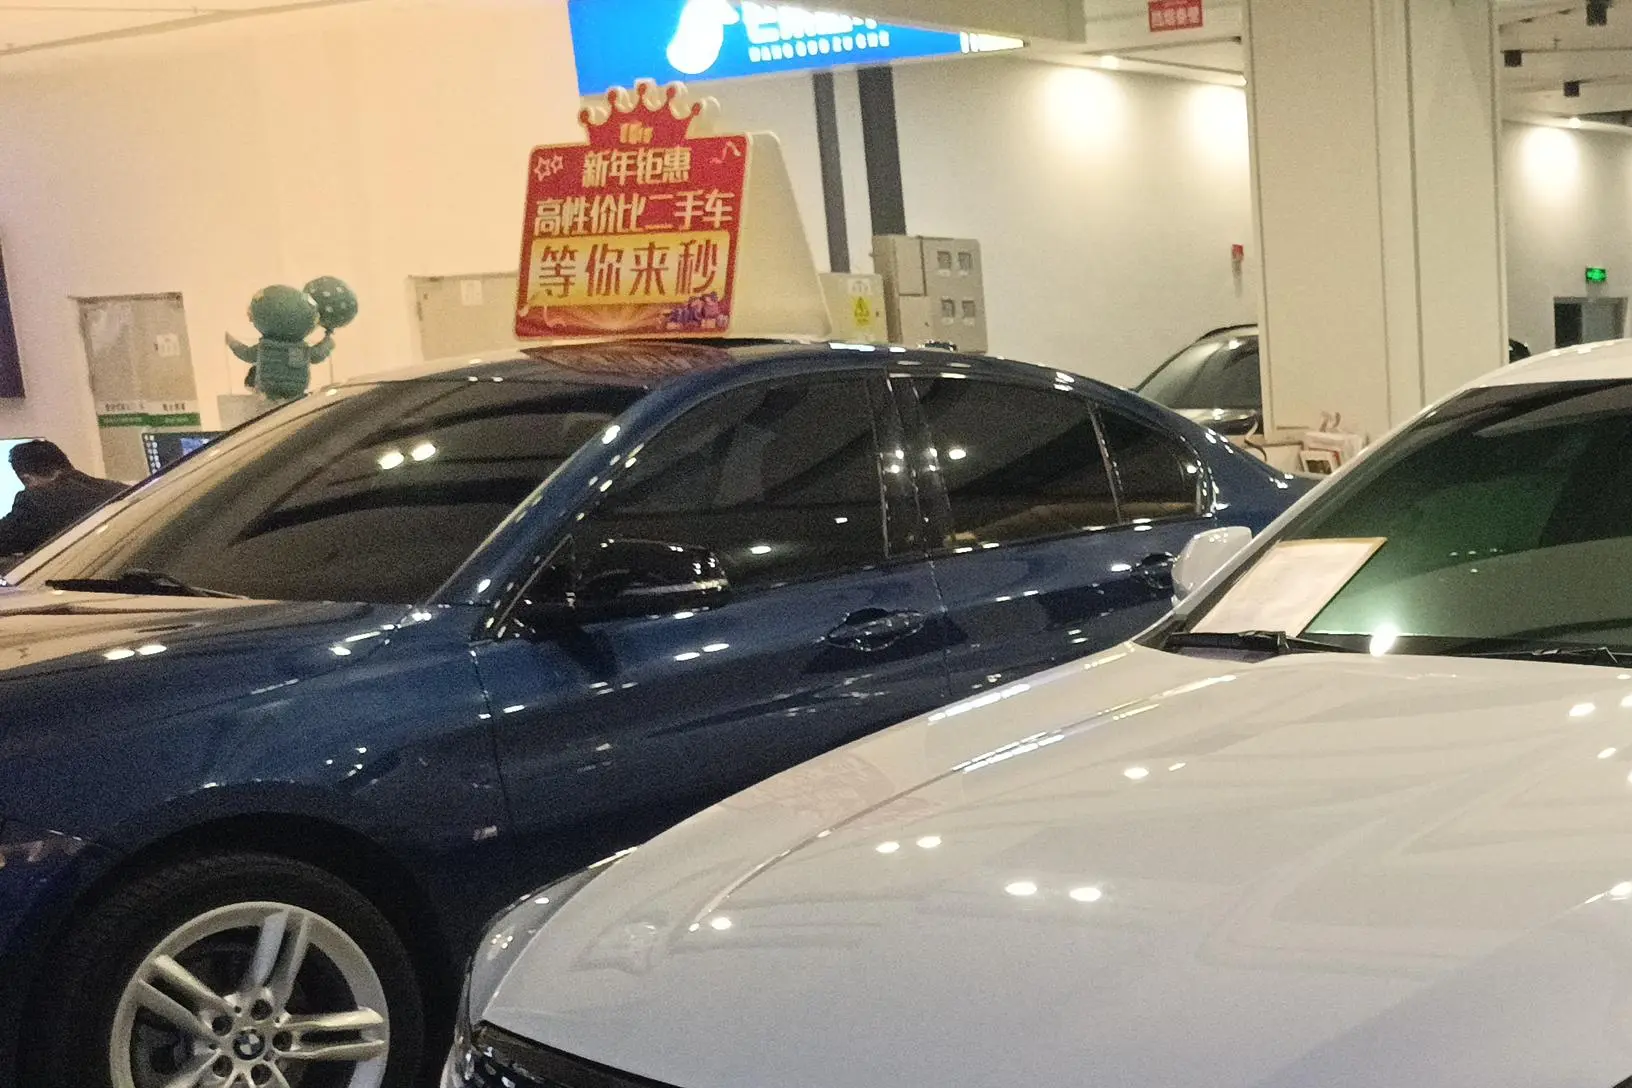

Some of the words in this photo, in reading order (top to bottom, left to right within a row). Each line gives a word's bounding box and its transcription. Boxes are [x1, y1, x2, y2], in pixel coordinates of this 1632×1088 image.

[534, 189, 735, 236] 高性价比二手车
[539, 239, 717, 298] 等你来秒
